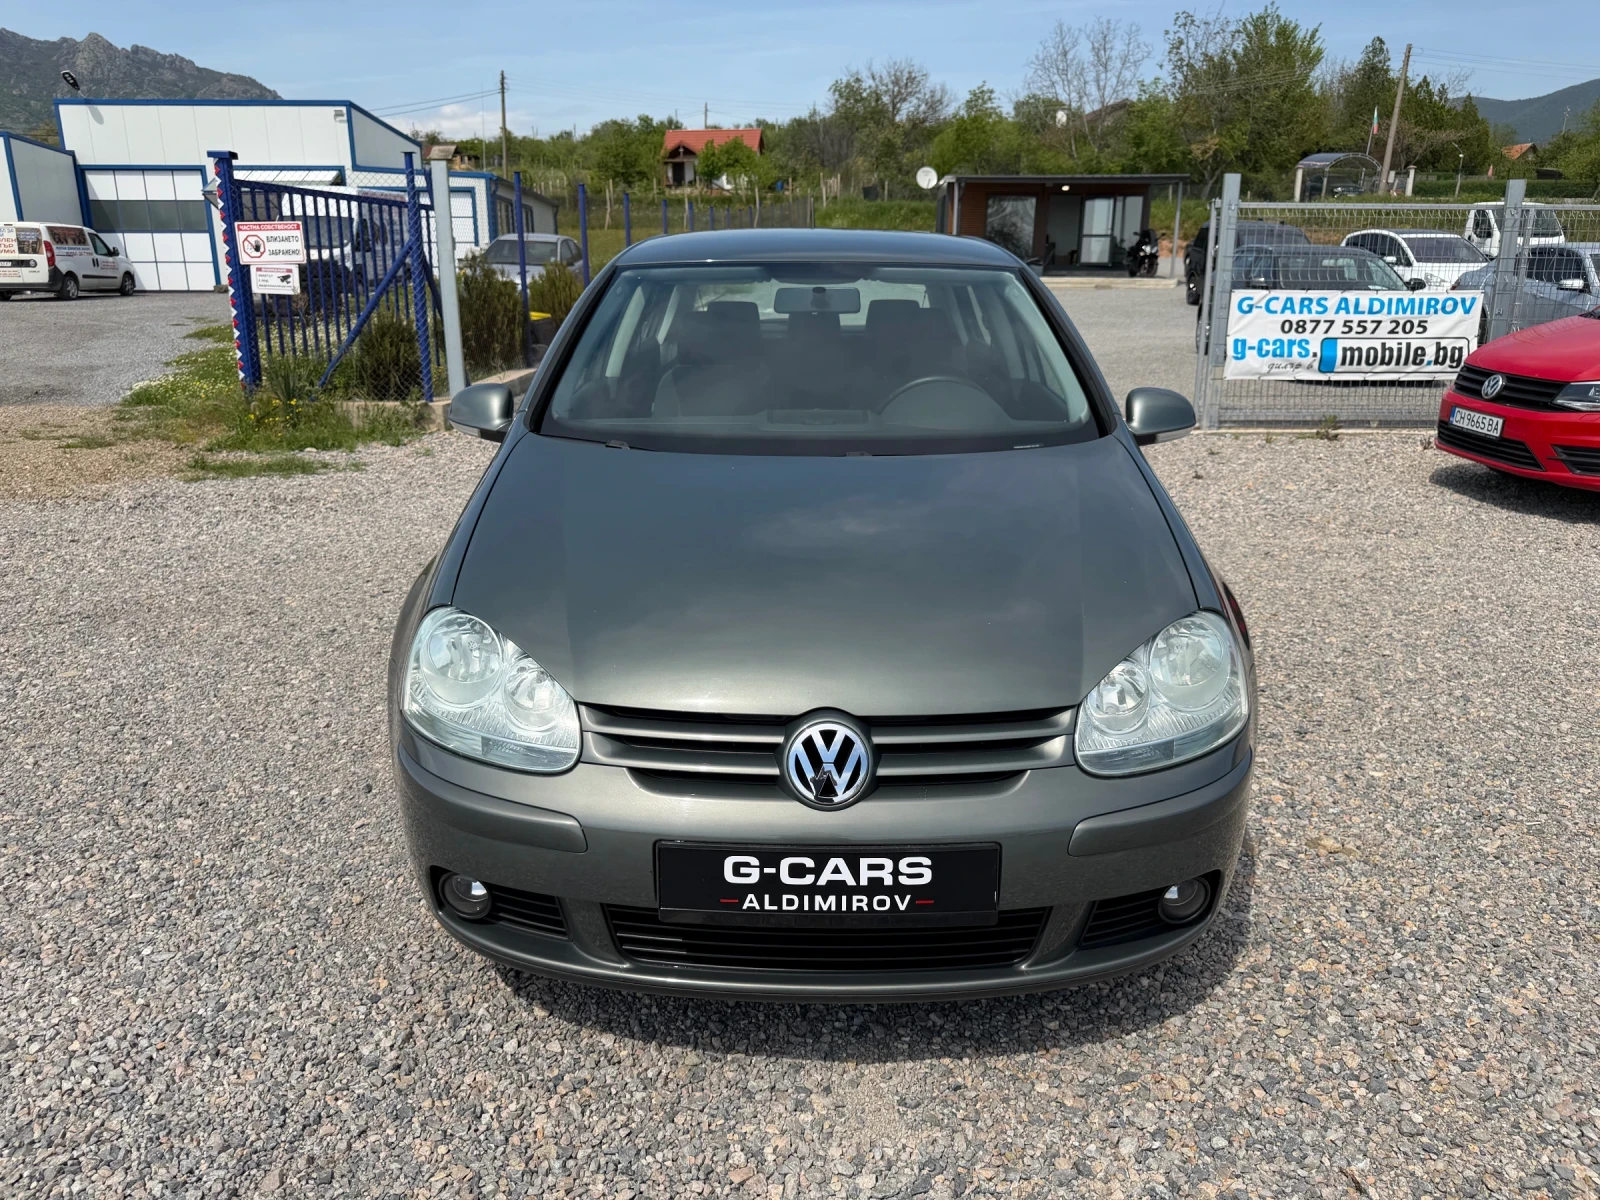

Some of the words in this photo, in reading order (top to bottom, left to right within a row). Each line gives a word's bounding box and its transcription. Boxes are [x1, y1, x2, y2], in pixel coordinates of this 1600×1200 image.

[266, 235, 300, 243] ВЛИЗАНЕТО
[1237, 296, 1328, 315] G-CARS
[1335, 296, 1477, 315] ALDIMIROV
[1280, 319, 1336, 335] 0877
[1341, 319, 1382, 335] 557
[1387, 319, 1429, 335] 205
[1340, 341, 1464, 370] mobile.bg
[788, 720, 870, 804] VW
[723, 855, 933, 886] G-CARS
[742, 894, 912, 911] ALDIMIROV
